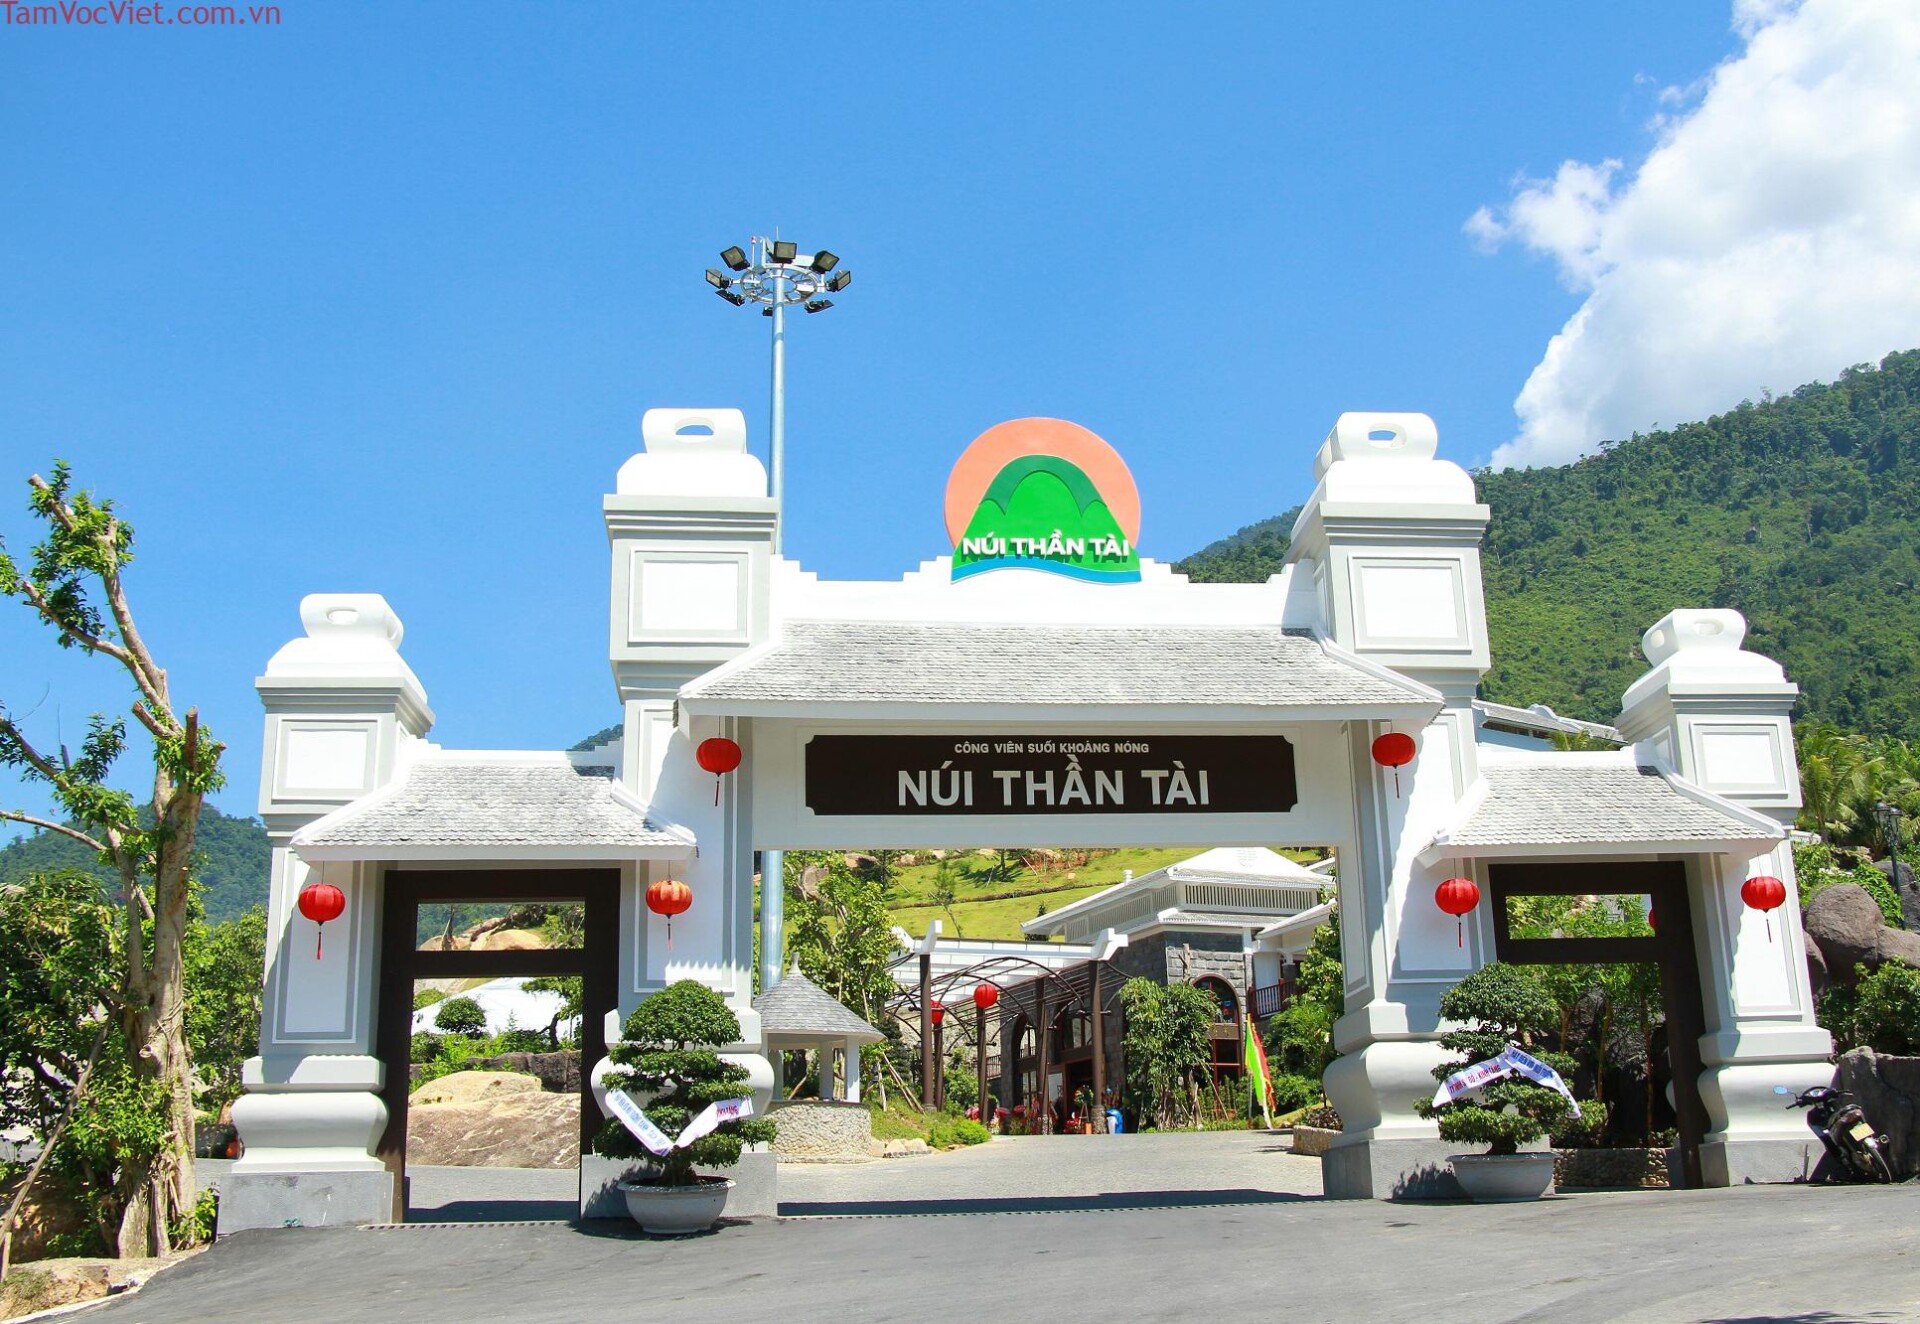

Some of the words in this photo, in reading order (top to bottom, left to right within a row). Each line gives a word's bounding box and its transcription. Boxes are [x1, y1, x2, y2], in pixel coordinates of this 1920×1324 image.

[963, 532, 1006, 555] NÚI
[1011, 529, 1085, 556] THẦN
[1090, 533, 1130, 556] TÀI
[954, 740, 989, 754] CÔNG
[994, 740, 1024, 754] VIÊN
[1027, 739, 1056, 754] SUỐI
[1115, 740, 1150, 754] NÓNG
[898, 761, 973, 806] NÚI
[993, 754, 1125, 806] THẦN
[1141, 761, 1210, 805] TÀI
